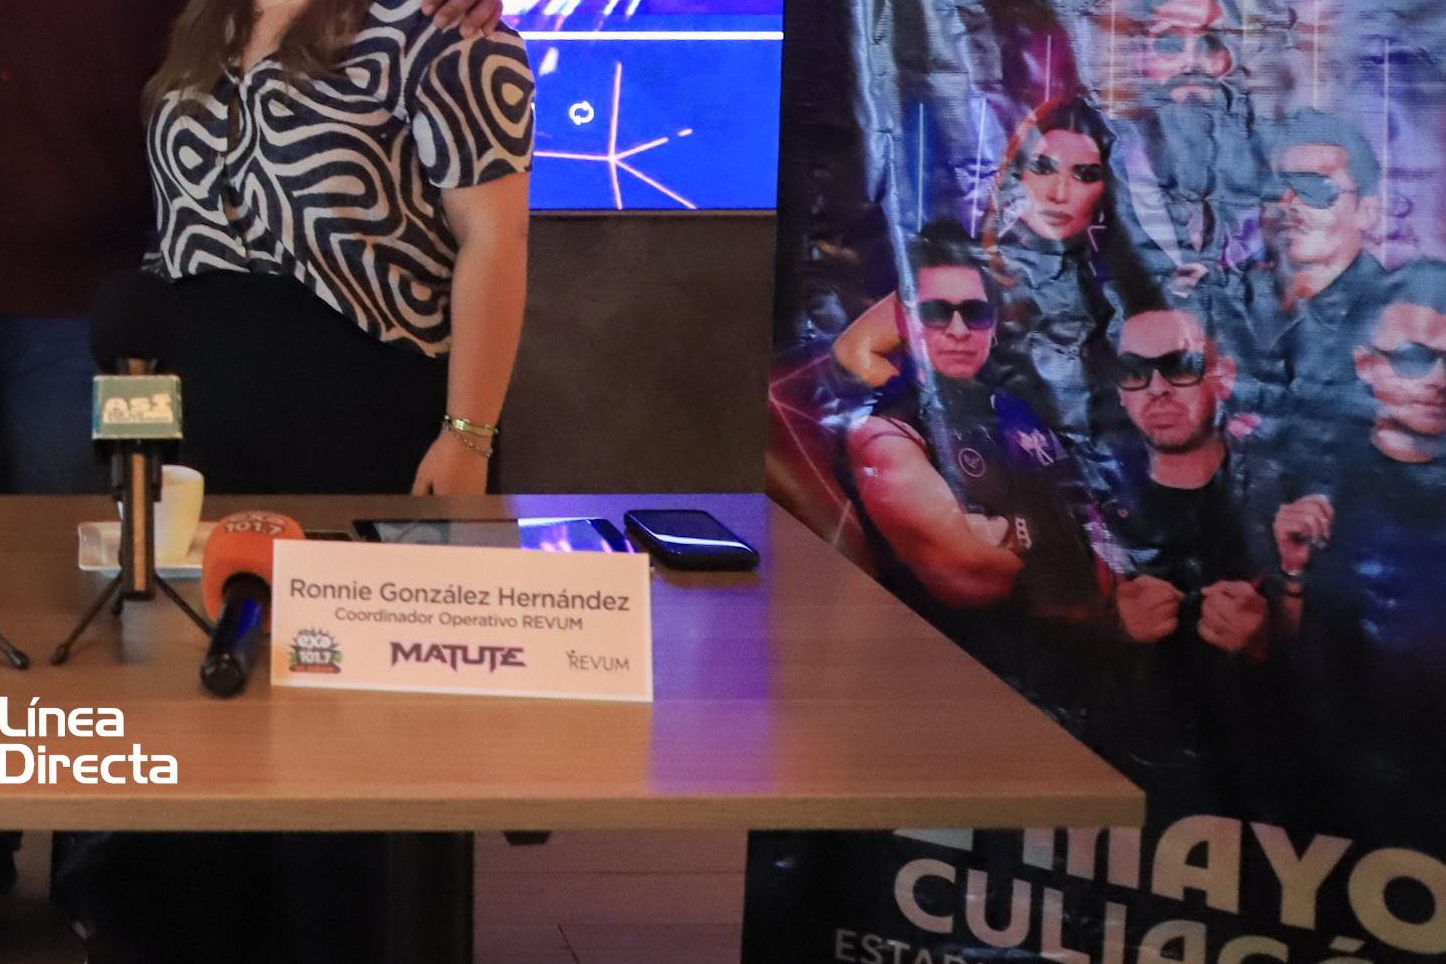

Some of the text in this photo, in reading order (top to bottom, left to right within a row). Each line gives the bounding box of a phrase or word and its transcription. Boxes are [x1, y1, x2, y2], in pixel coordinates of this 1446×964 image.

[290, 578, 631, 612] Ronnie González Hernández
[334, 607, 584, 631] Coordinador Operativo REVUM
[390, 642, 527, 674] MATUTE
[567, 652, 631, 671] REVUM
